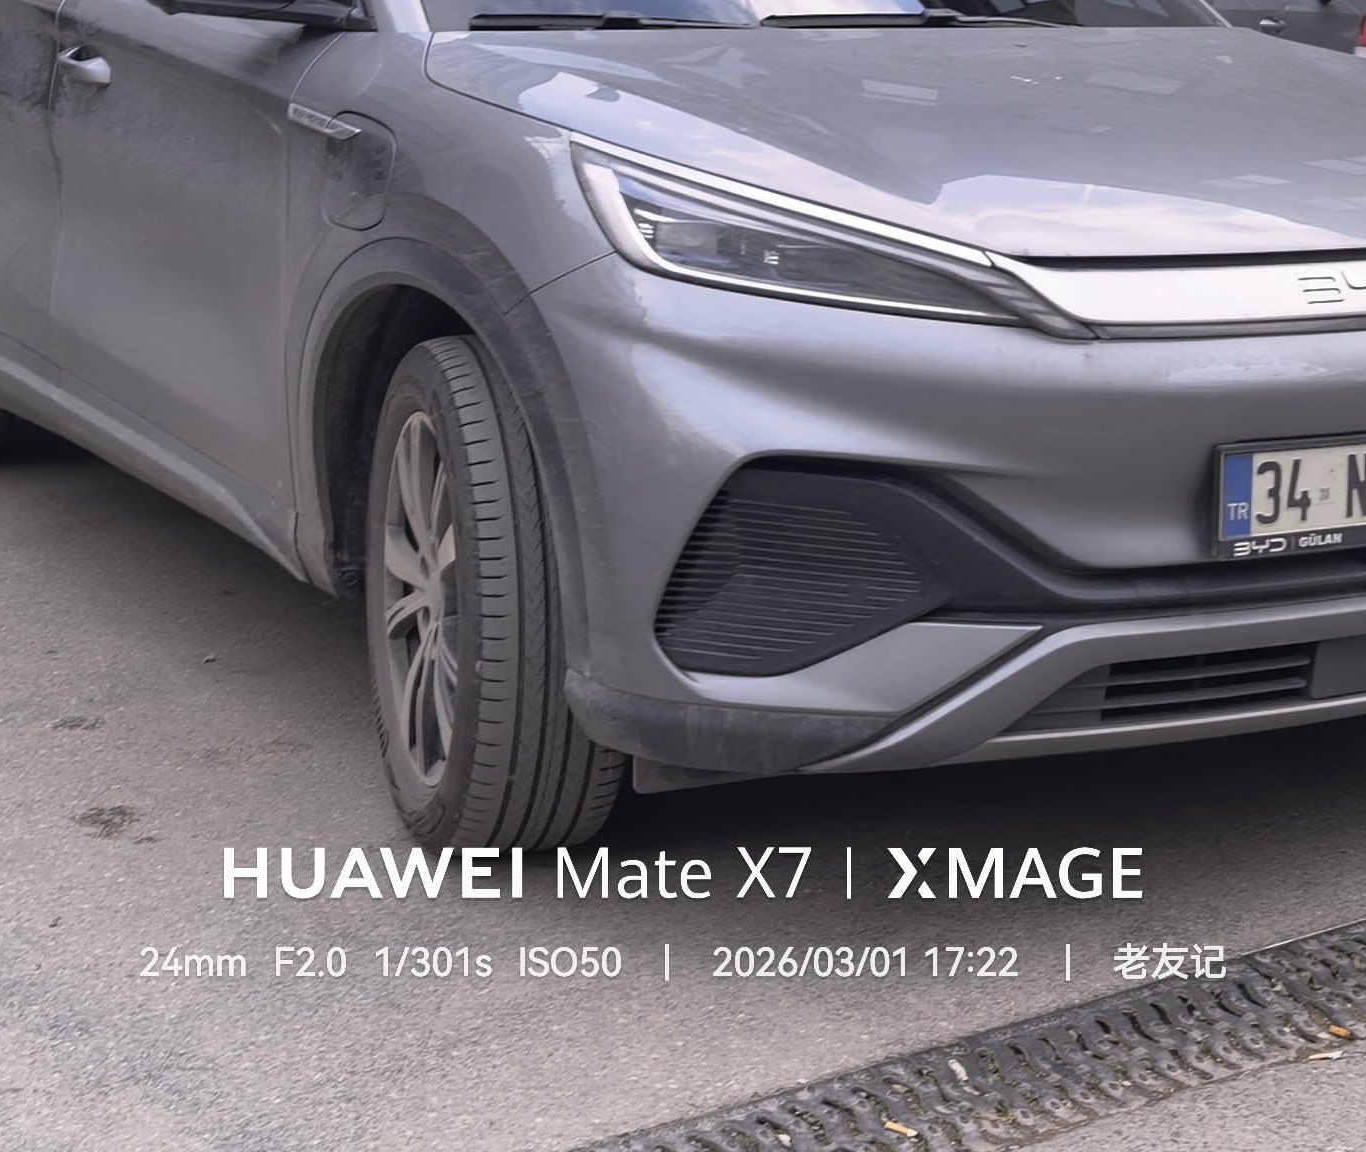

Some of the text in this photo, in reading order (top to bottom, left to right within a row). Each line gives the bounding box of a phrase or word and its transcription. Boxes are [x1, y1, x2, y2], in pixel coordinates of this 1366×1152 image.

[1255, 459, 1312, 525] 34
[1227, 502, 1249, 521] TR
[1233, 532, 1343, 557] BYD GÜLAN
